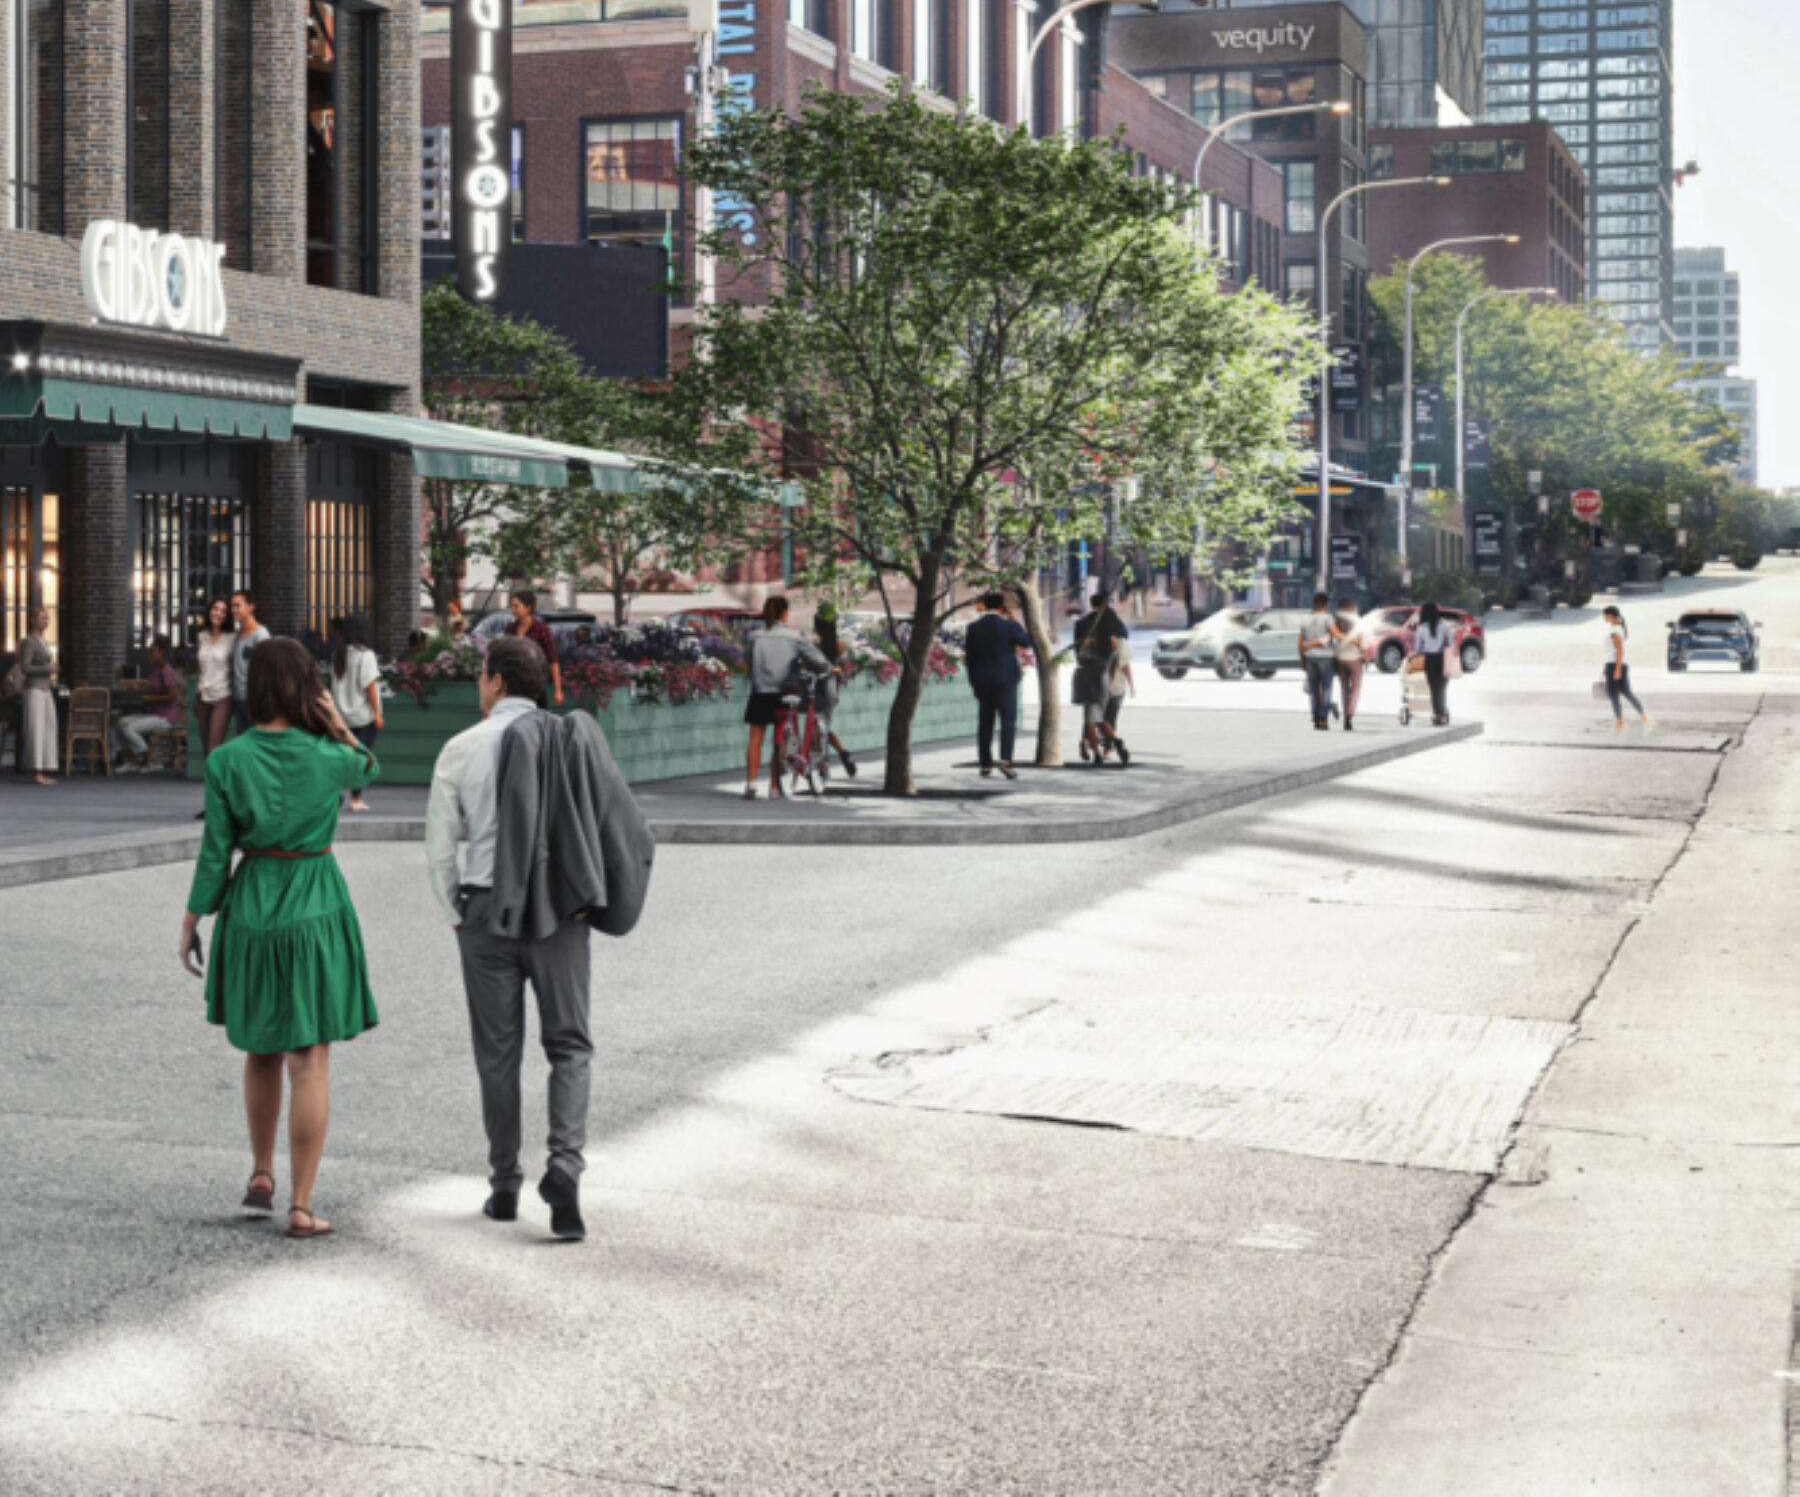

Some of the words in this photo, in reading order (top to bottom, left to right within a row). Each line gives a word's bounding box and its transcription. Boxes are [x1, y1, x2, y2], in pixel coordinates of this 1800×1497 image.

[1211, 21, 1315, 53] vequity
[80, 220, 227, 336] GIBSONS
[1574, 497, 1601, 507] STOP
